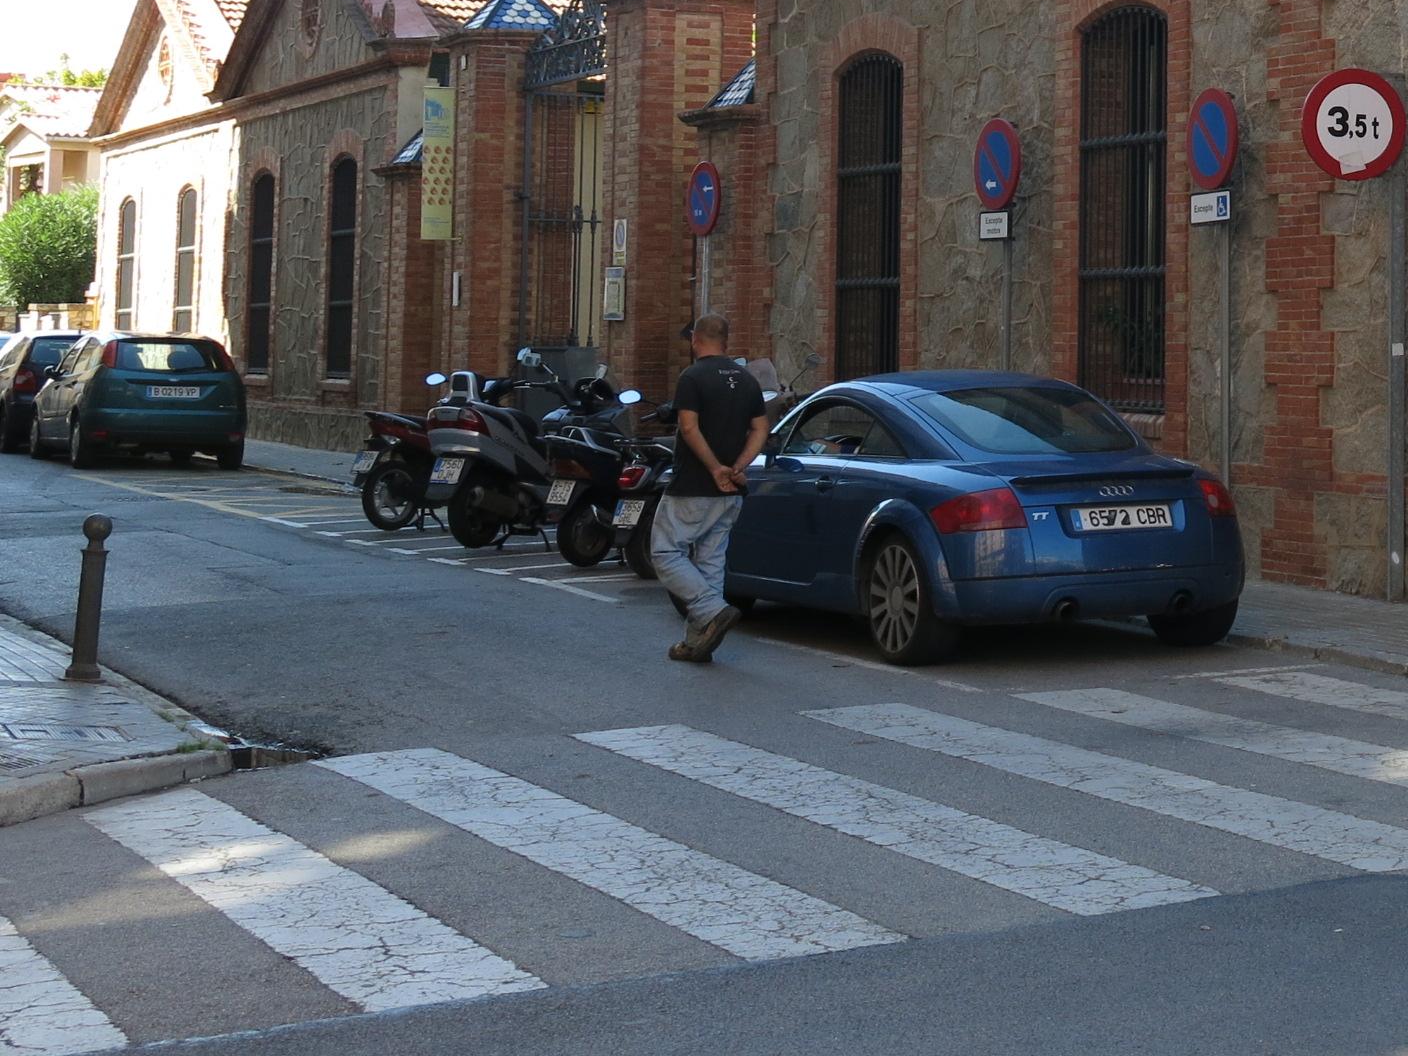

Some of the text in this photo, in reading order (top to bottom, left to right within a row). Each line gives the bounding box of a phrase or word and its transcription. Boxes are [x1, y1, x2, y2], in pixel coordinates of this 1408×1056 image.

[1327, 105, 1380, 140] 3,5 t
[154, 387, 161, 396] B
[1032, 511, 1050, 521] TT
[1088, 507, 1168, 527] 6572 CBR
